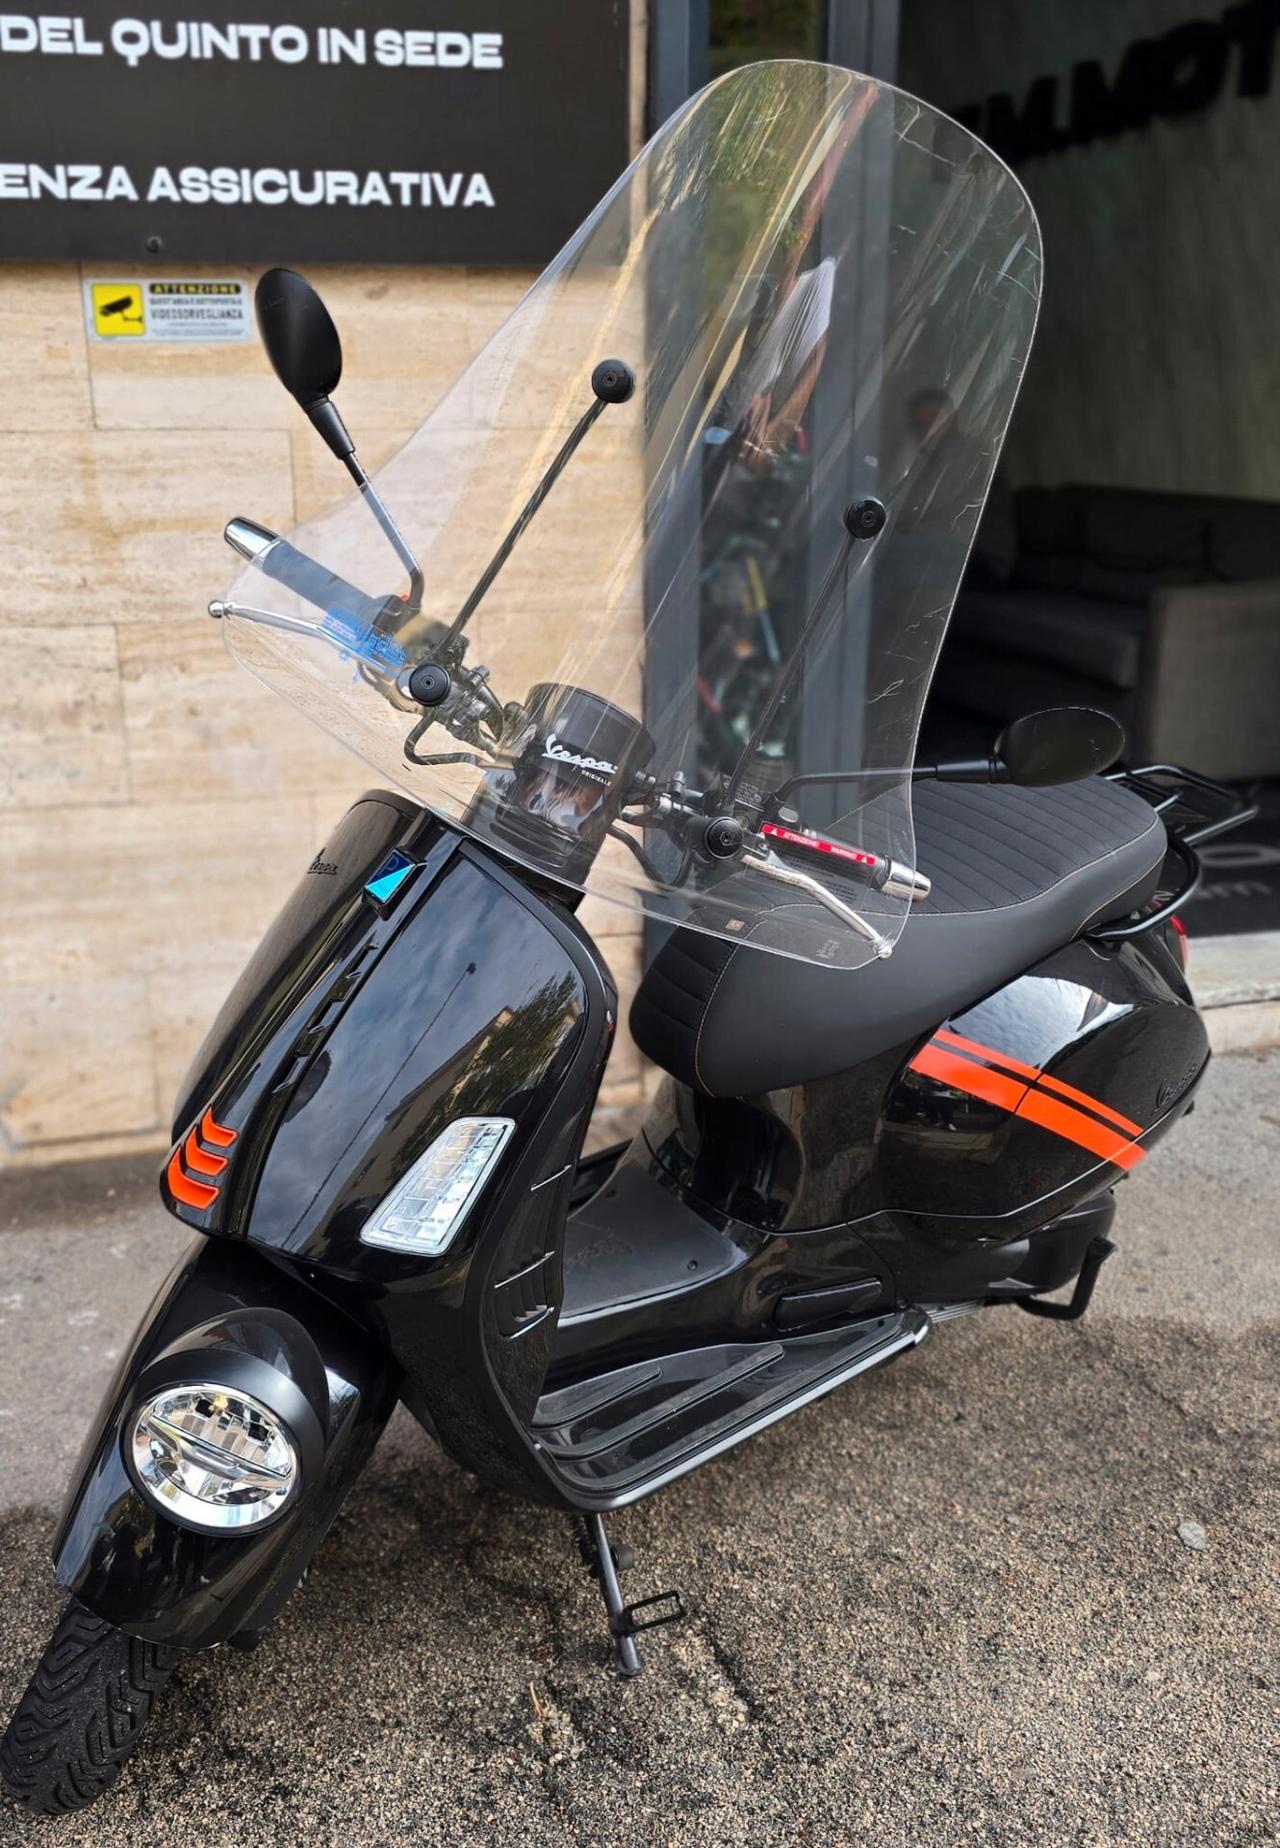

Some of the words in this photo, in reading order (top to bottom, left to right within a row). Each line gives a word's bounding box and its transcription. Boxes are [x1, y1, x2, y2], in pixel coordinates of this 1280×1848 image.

[0, 14, 103, 55] DEL
[111, 18, 309, 67] QUINTO
[317, 28, 367, 65] IN
[373, 29, 504, 69] SEDE
[0, 163, 139, 201] ENZA
[146, 167, 495, 207] ASSICURATIVA
[154, 284, 236, 294] ATTENZIONE
[541, 733, 618, 775] Vespa
